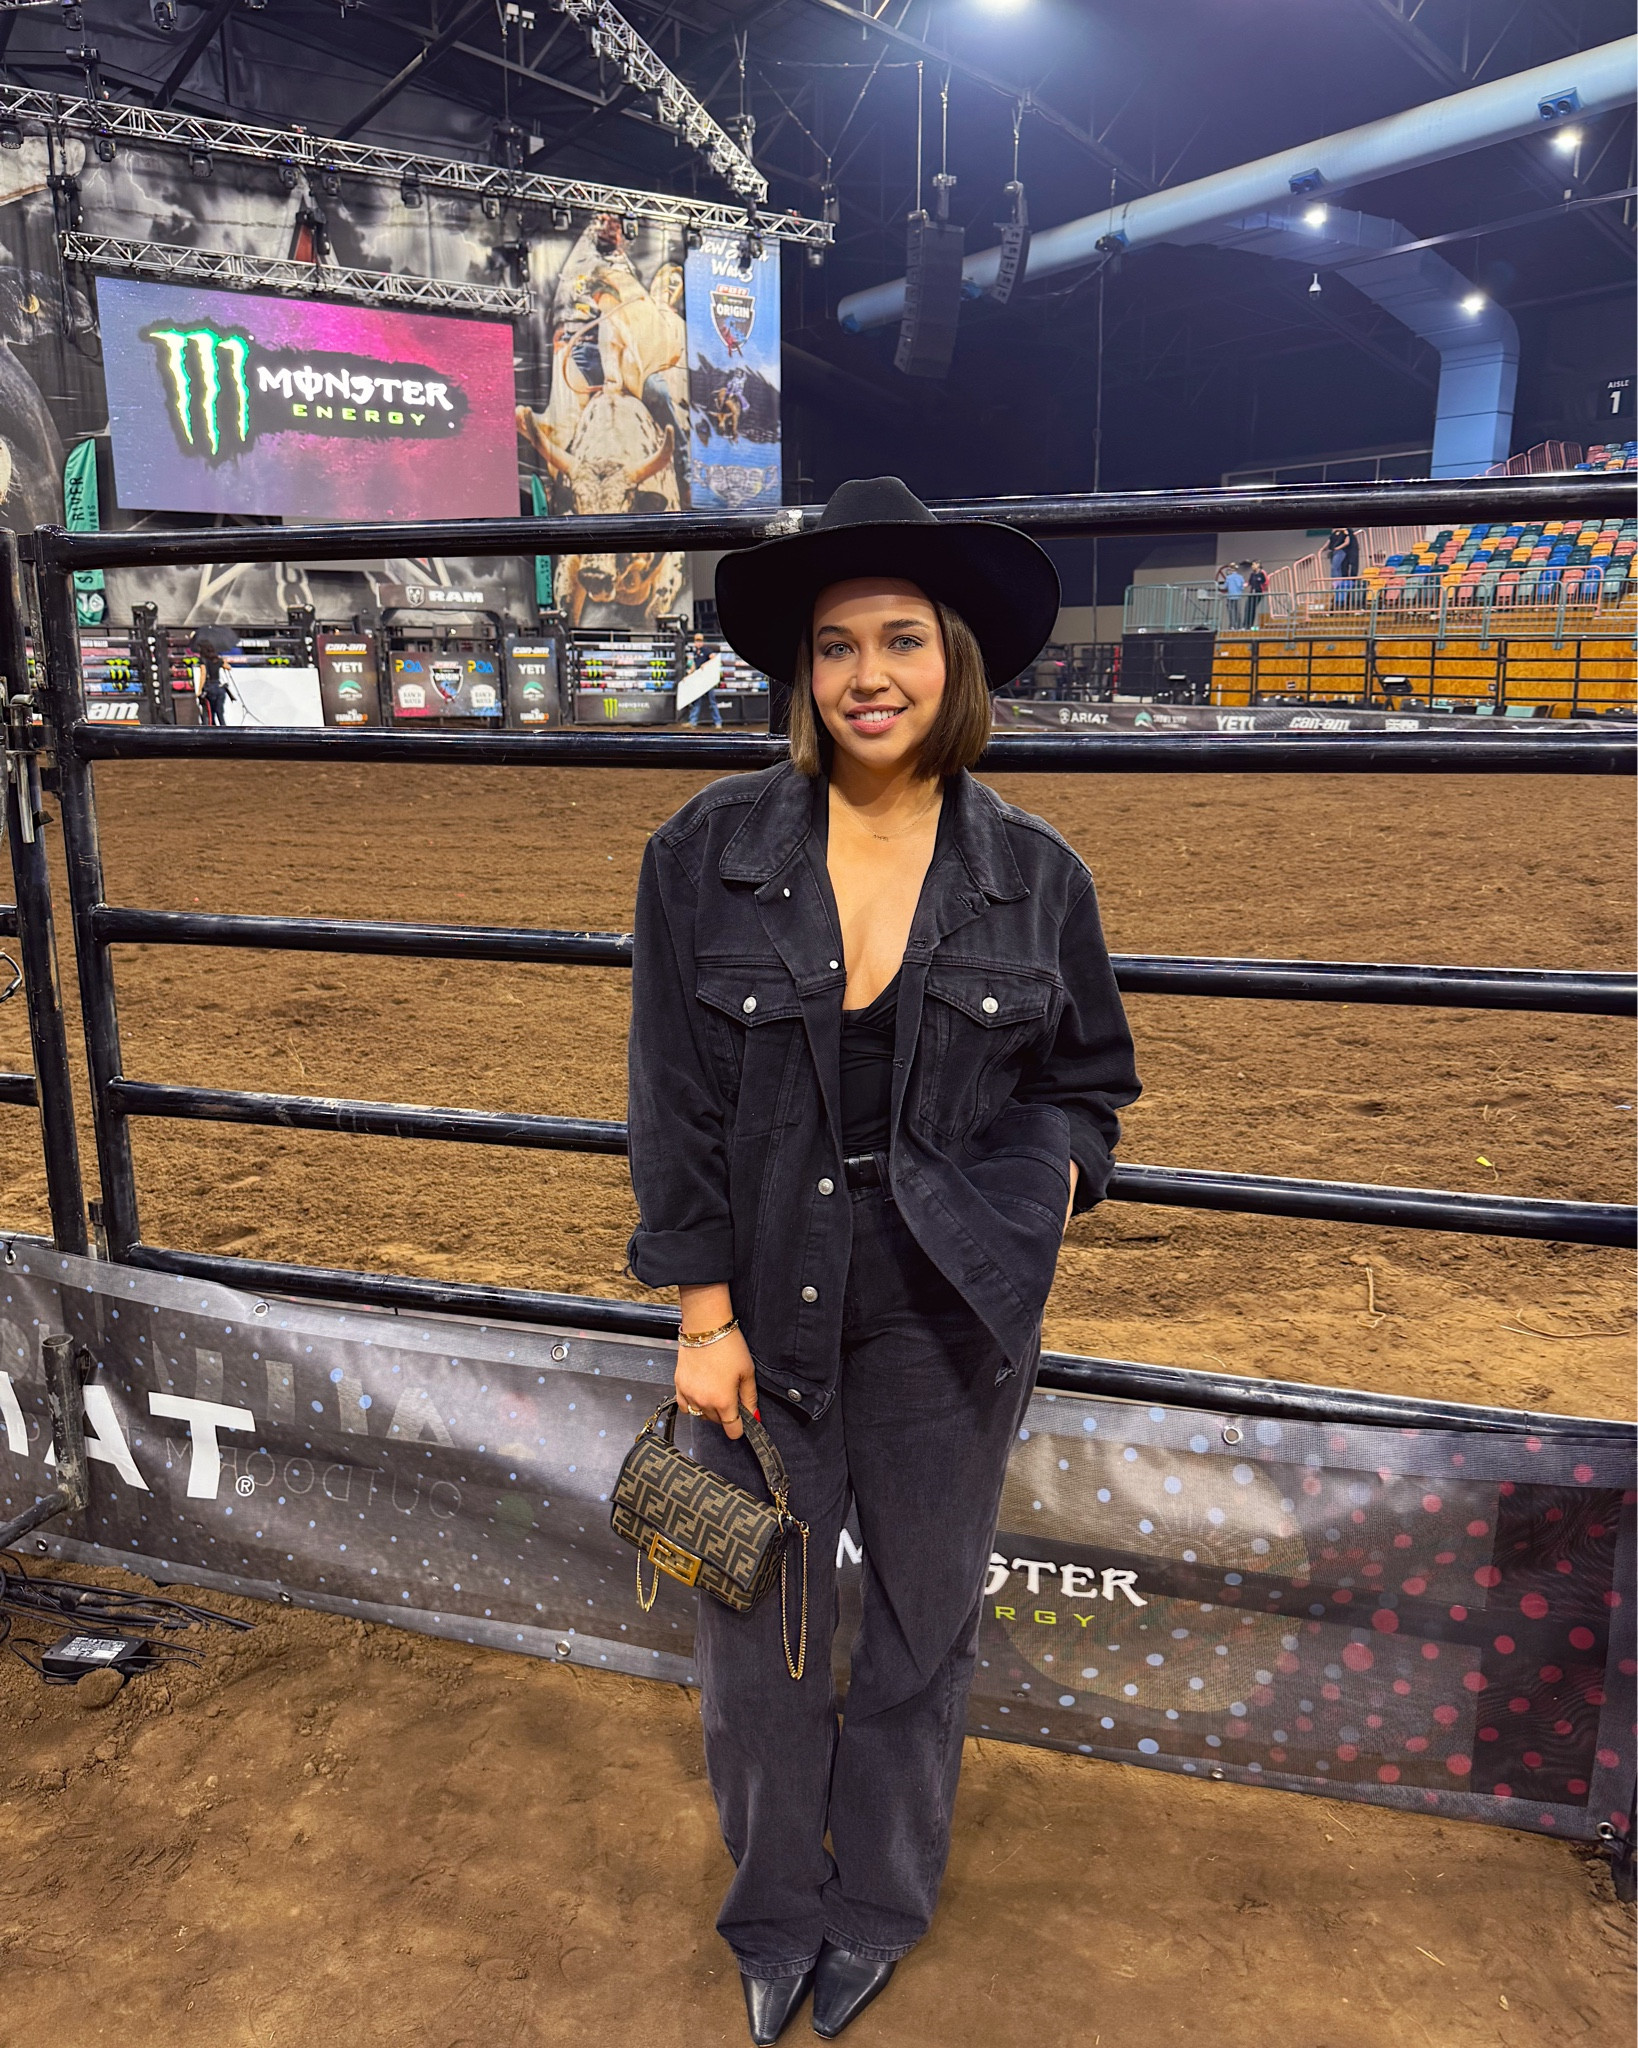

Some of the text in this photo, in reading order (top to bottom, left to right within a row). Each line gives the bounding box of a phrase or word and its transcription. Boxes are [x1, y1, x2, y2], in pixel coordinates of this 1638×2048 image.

[716, 304, 750, 318] ORIGIN
[256, 366, 454, 411] MONSTER
[1608, 380, 1630, 389] AISLE
[1610, 391, 1621, 414] 1
[292, 403, 427, 427] ENERGY
[69, 476, 84, 522] RIVER
[429, 590, 484, 603] RAM
[332, 661, 363, 673] YETI
[395, 659, 424, 673] POA
[467, 660, 494, 673] POA
[518, 663, 546, 675] YETI
[1070, 712, 1109, 725] ARIAT
[1290, 716, 1352, 731] can-am
